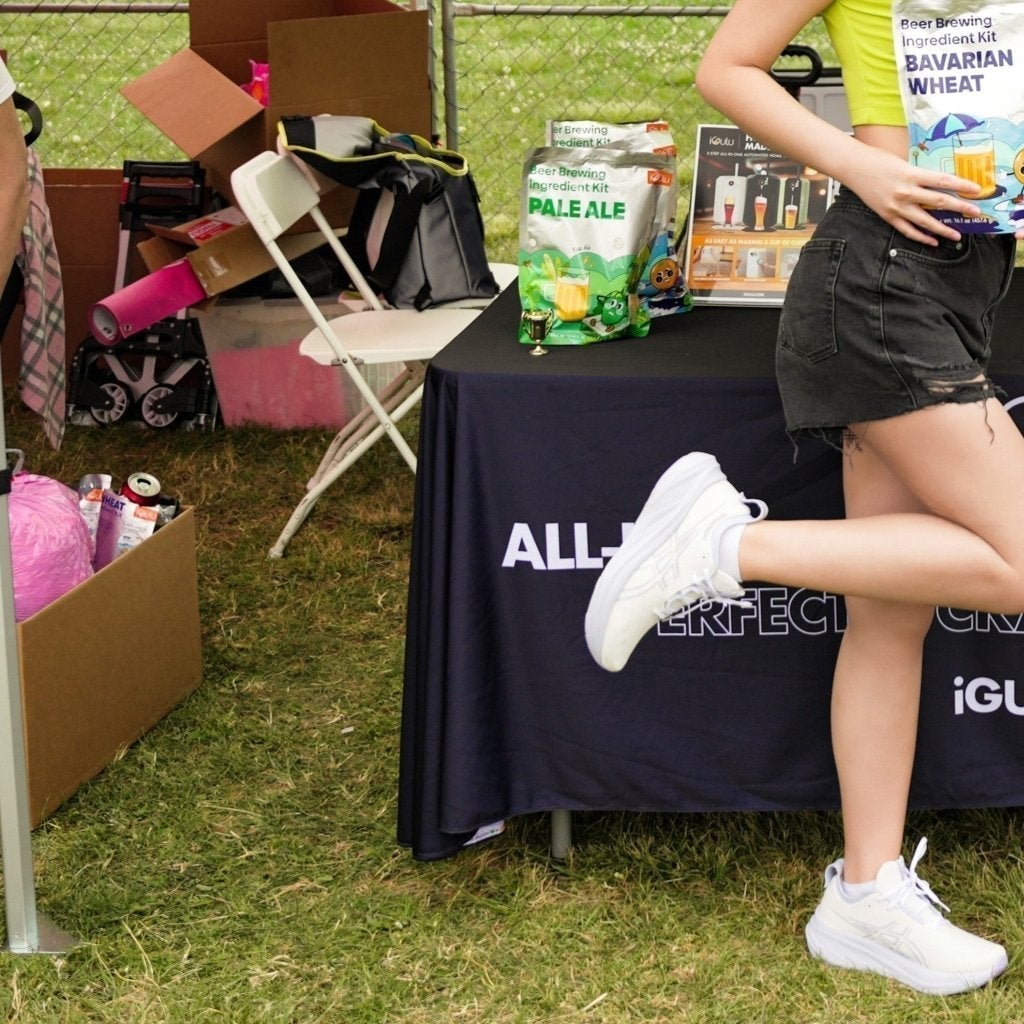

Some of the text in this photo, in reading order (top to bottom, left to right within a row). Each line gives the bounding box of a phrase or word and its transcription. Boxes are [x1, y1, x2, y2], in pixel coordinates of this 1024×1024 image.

[901, 15, 993, 30] Beer Brewing
[902, 30, 998, 49] Ingredient Kit
[905, 49, 1014, 72] BAVARIAN
[908, 75, 985, 96] WHEAT
[565, 125, 608, 136] Brewing
[529, 165, 606, 181] Beer Brewing
[529, 179, 609, 194] Ingredient Kit
[528, 197, 626, 220] PALE ALE
